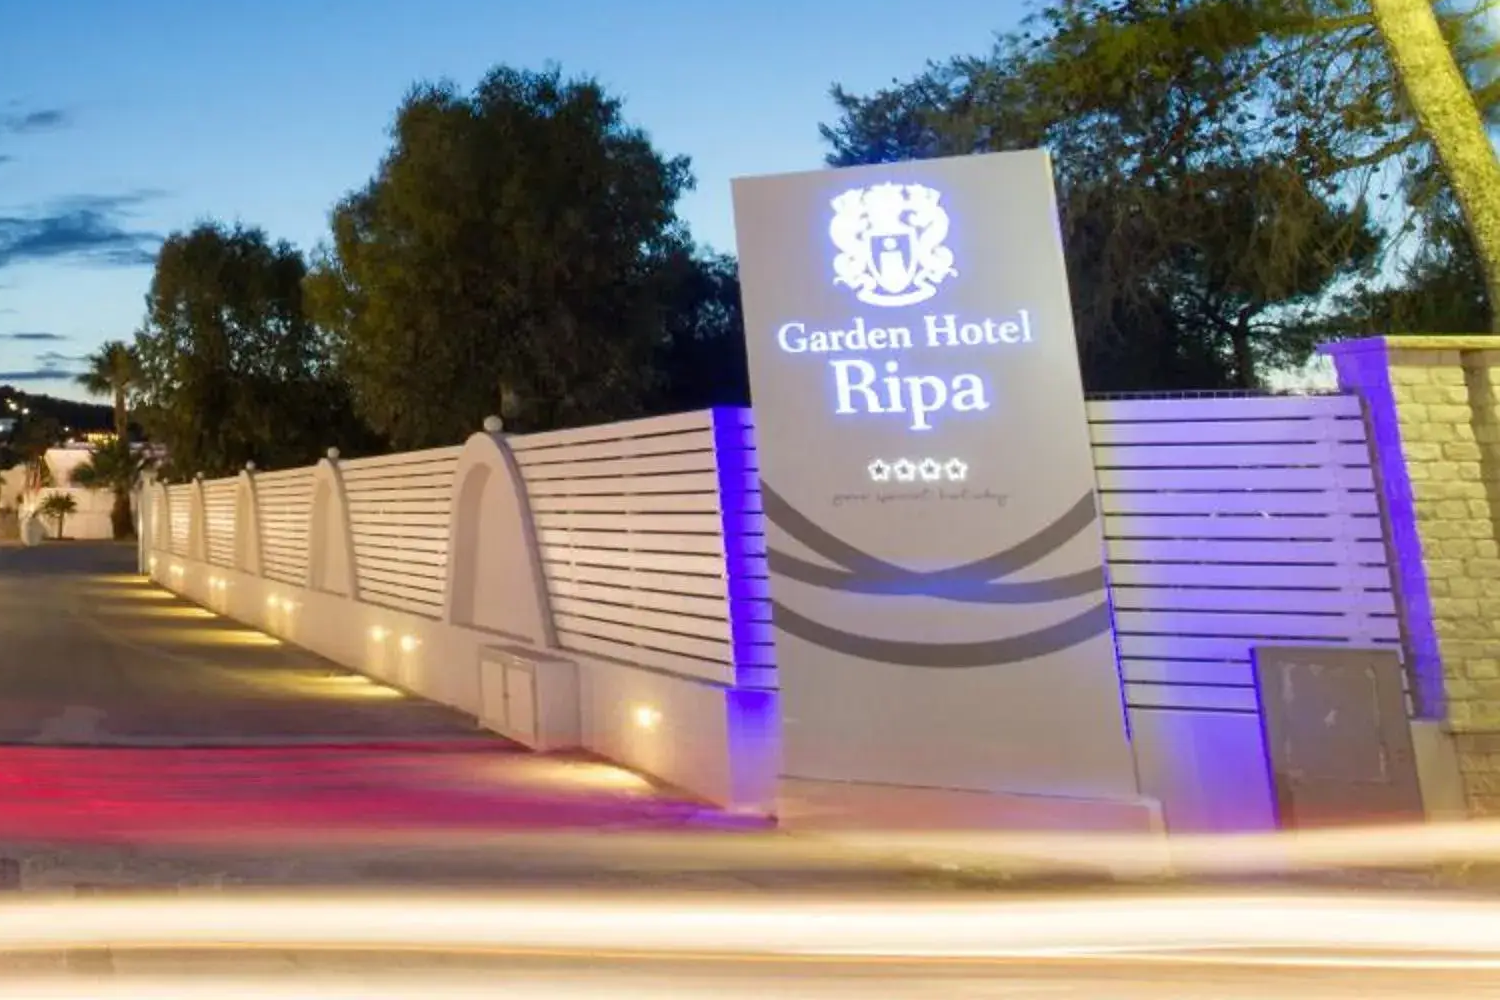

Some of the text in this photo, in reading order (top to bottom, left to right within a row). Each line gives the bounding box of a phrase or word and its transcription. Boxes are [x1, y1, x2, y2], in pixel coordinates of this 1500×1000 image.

[777, 309, 1034, 353] Garden Hotel
[829, 359, 990, 431] Ripa
